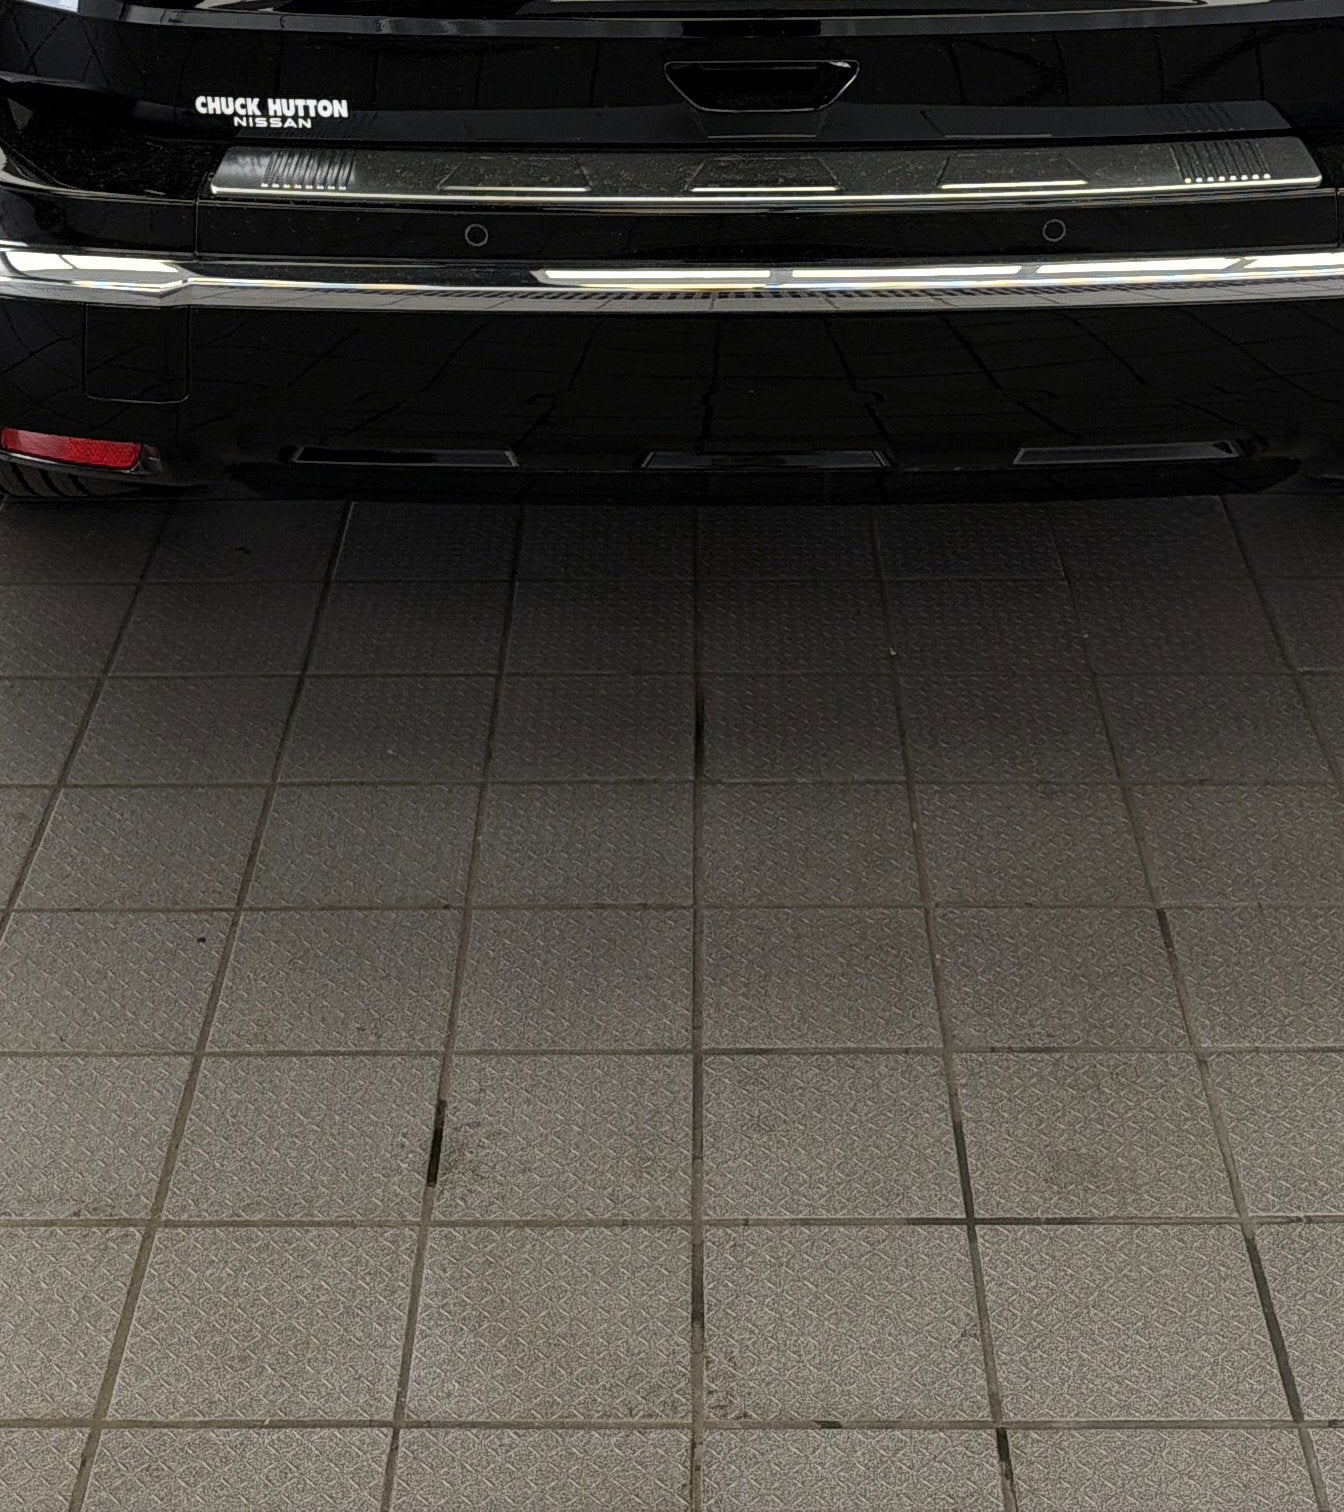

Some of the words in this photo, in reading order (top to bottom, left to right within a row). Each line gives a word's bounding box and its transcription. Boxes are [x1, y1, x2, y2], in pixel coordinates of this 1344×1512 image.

[195, 96, 261, 115] CHUCK
[267, 98, 349, 118] HUTTON
[233, 116, 312, 129] NISSAN
